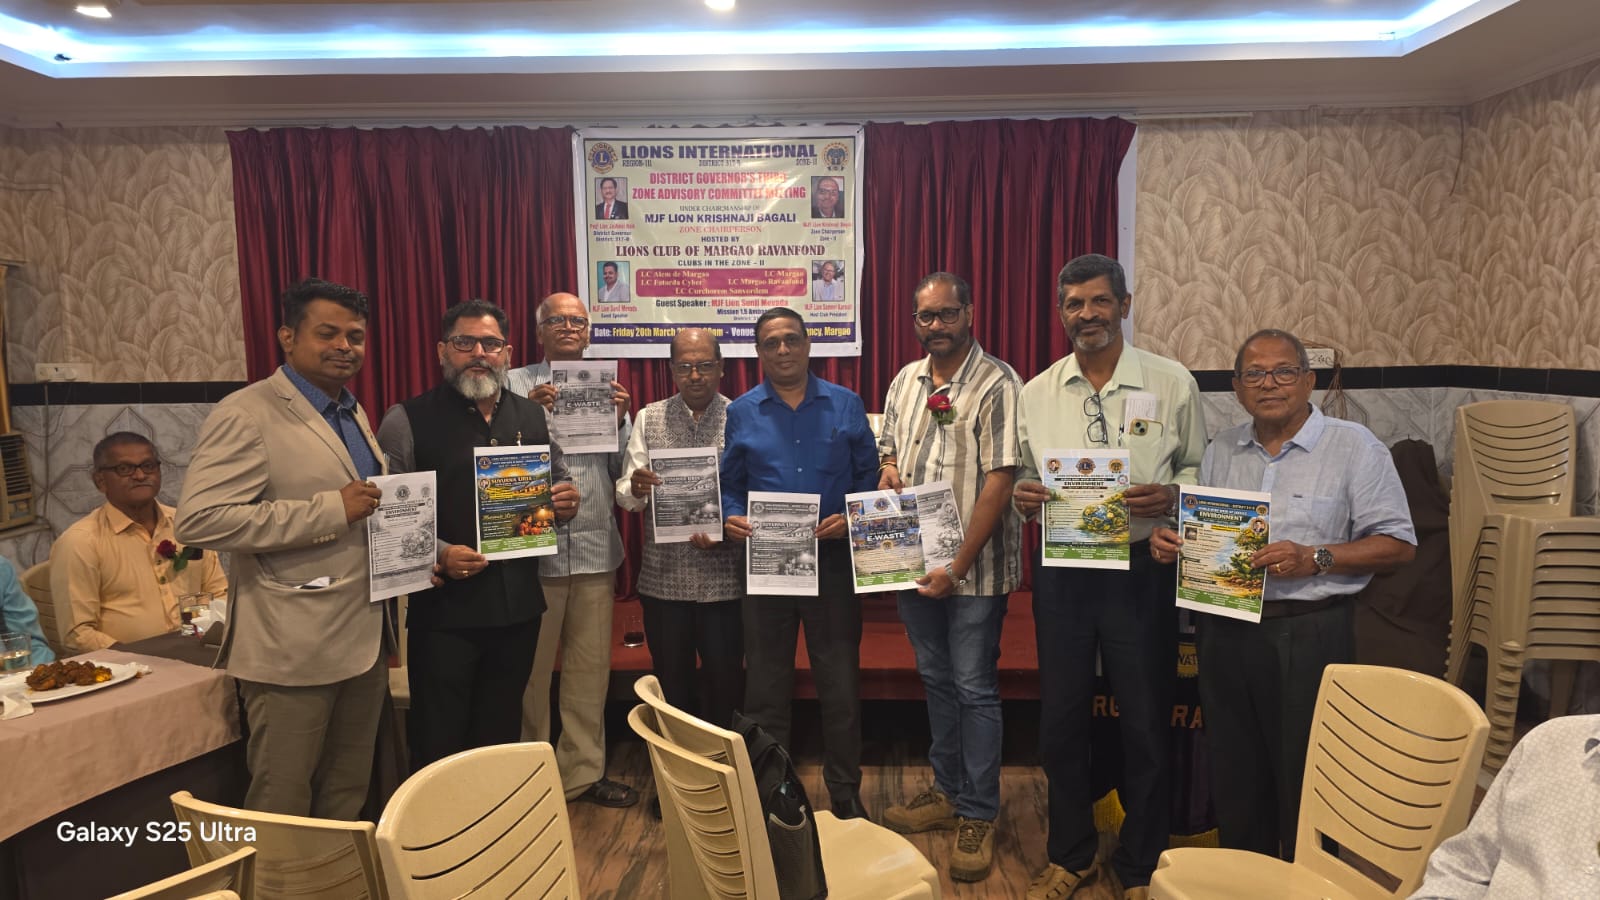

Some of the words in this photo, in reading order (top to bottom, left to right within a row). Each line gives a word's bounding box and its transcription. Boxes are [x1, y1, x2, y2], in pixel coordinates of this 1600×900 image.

[622, 146, 674, 159] LIONS
[679, 144, 818, 158] INTERNATIONAL
[650, 172, 694, 184] DISTRICT
[632, 188, 656, 200] ZONE
[658, 188, 706, 200] ADVISORY
[708, 188, 762, 199] COMMITTEE
[644, 214, 665, 223] MJF
[668, 214, 694, 223] LION
[697, 214, 754, 223] KRISHNAJI
[757, 213, 796, 222] BAGALI
[703, 225, 762, 233] CHAIRPERSON
[616, 246, 649, 256] LIONS
[653, 246, 680, 256] CLUB
[685, 246, 700, 256] OF
[704, 245, 754, 256] MARGAO
[758, 245, 825, 256] RAVANFOND
[677, 299, 706, 308] Speaker
[594, 328, 612, 337] Date:
[613, 328, 635, 338] Friday
[636, 328, 652, 337] 20th
[653, 328, 675, 337] March
[824, 327, 851, 336] Margao
[1200, 512, 1243, 521] ENVIRONMENT
[867, 532, 905, 541] E-WASTE
